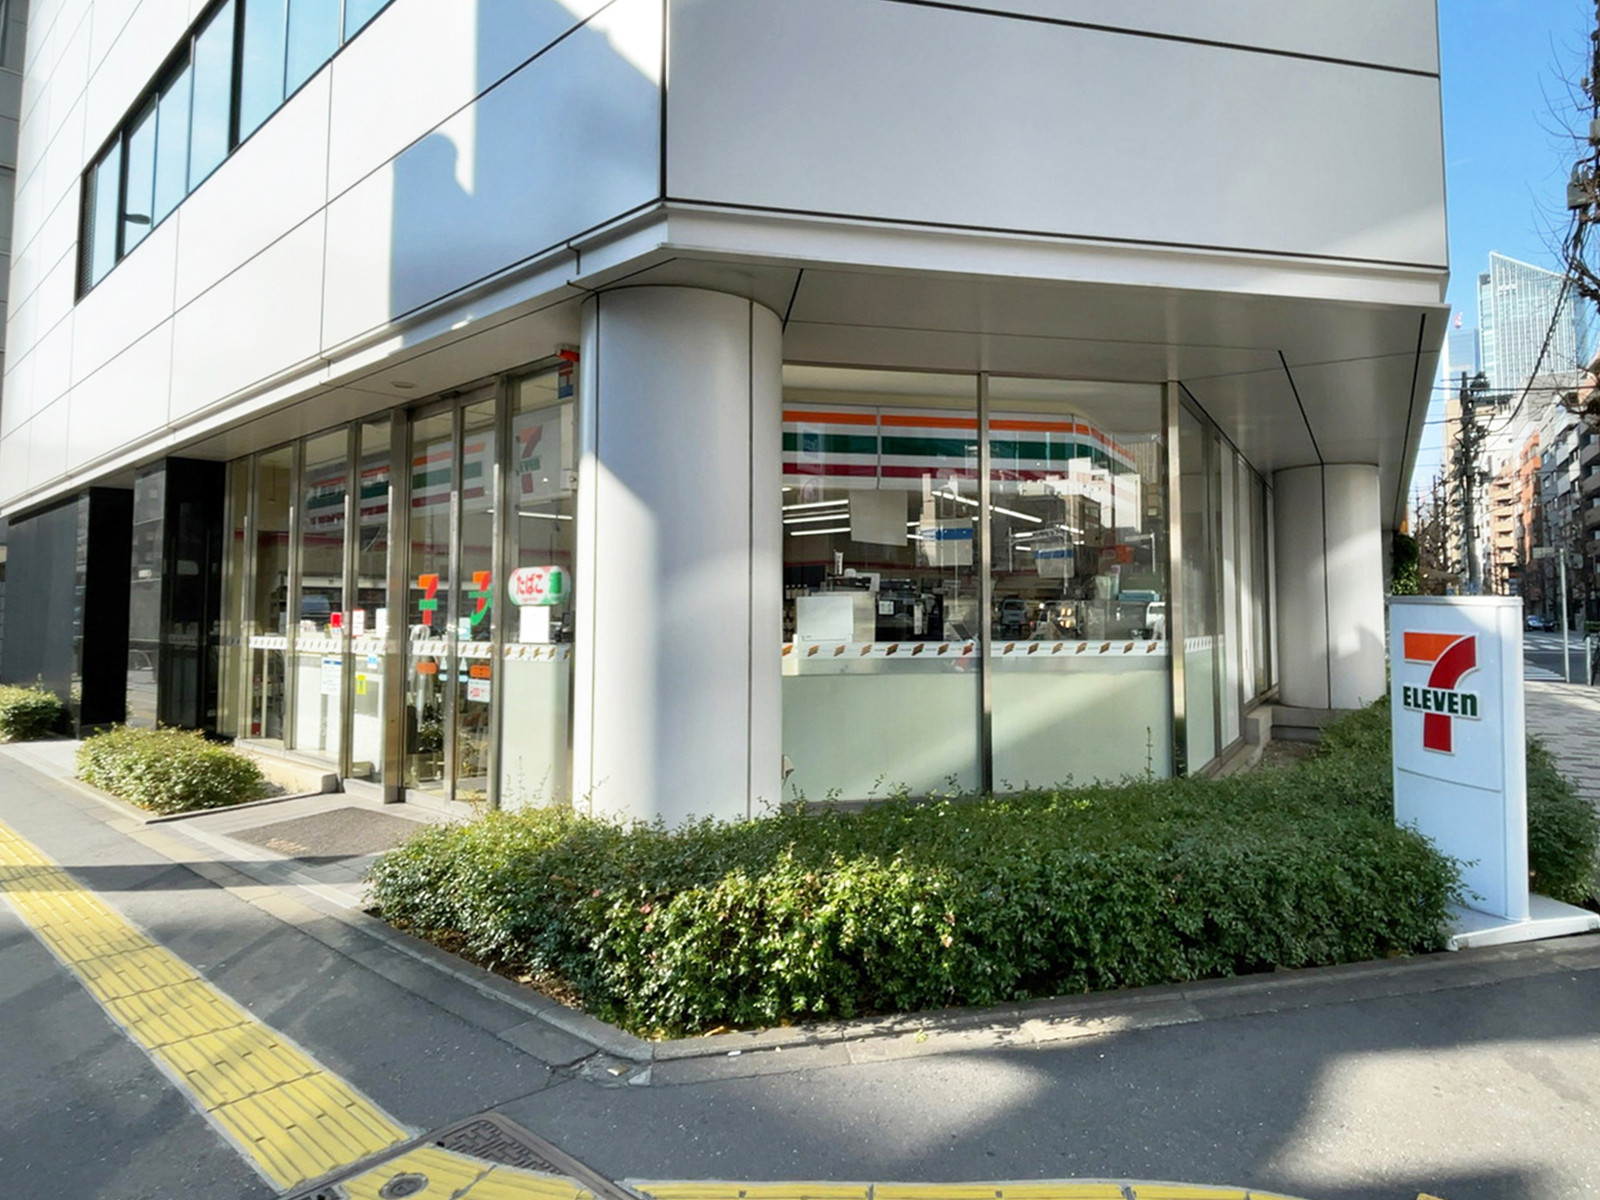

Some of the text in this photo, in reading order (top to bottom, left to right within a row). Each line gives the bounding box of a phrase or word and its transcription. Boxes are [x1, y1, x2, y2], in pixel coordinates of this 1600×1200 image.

[516, 574, 543, 595] たばこ
[1403, 632, 1477, 753] 7
